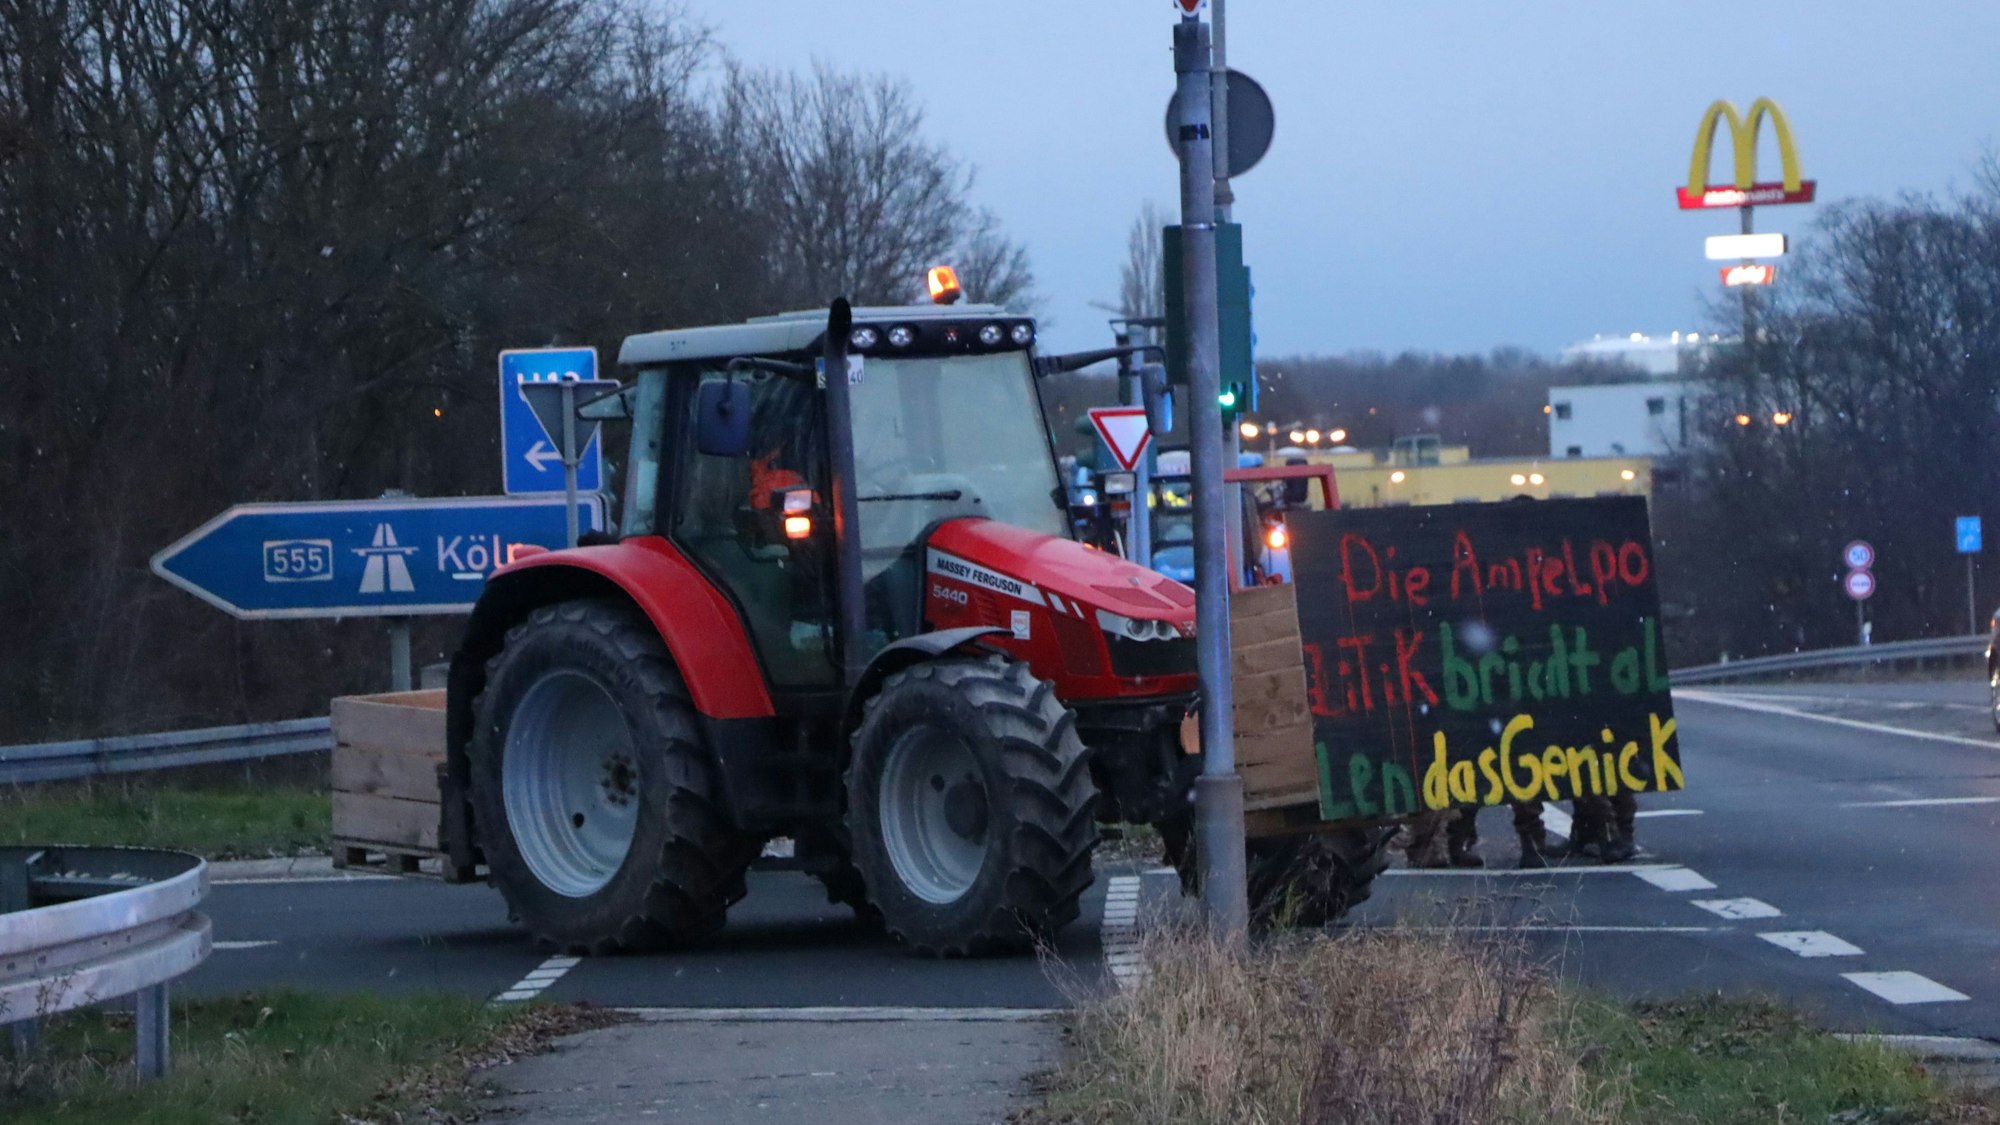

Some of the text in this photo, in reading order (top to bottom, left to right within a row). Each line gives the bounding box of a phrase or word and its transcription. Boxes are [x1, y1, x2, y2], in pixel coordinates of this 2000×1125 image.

[273, 549, 323, 573] 555
[937, 557, 1022, 596] MASSEY FERGUSON
[1339, 532, 1430, 605] Die
[933, 585, 968, 605] 5440
[1439, 621, 1600, 711] bricht
